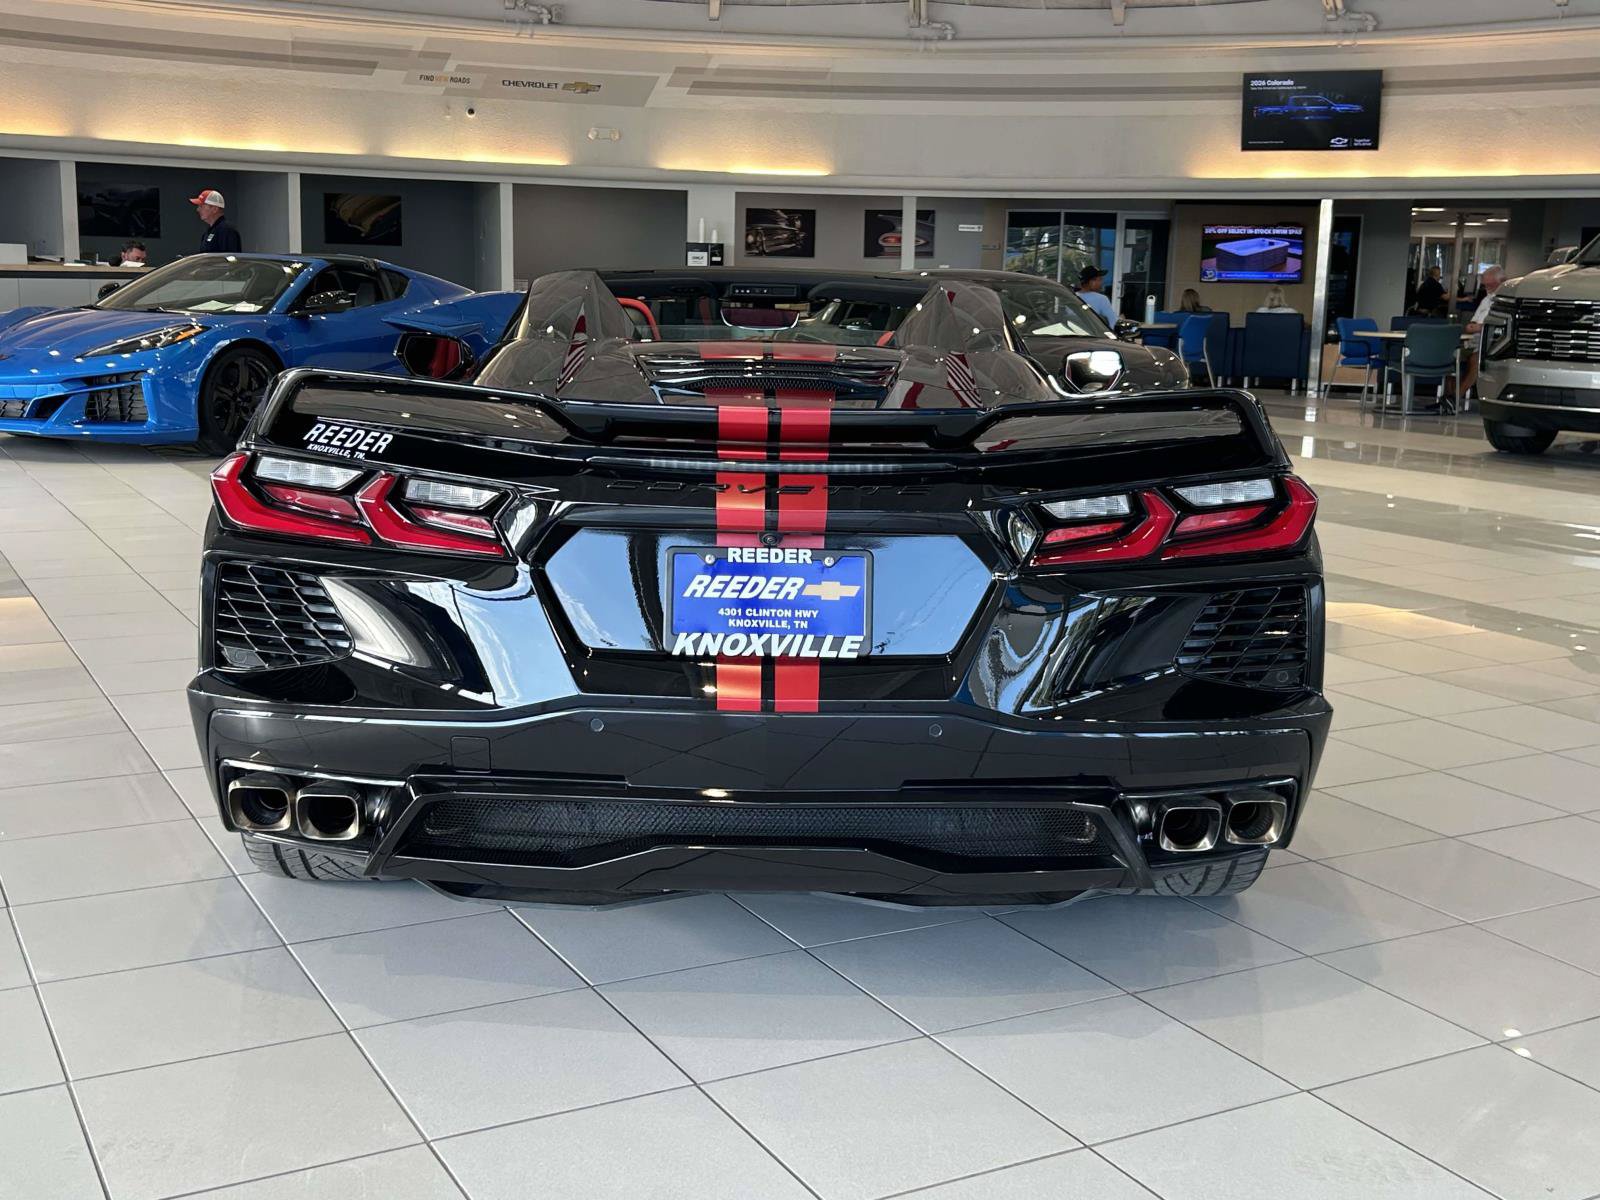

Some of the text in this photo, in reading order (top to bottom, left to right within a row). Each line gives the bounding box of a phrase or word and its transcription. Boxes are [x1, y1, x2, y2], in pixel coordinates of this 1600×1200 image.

[419, 74, 434, 82] FIND
[449, 76, 471, 84] ROADS
[502, 79, 559, 89] CHEVROLET
[1247, 228, 1272, 236] IN-STOCK
[1288, 228, 1302, 236] SPAS
[302, 423, 394, 454] REEDER
[307, 443, 351, 459] KNOXVILLE,
[606, 480, 933, 495] CORVETTE
[727, 547, 813, 564] REEDER
[682, 574, 805, 600] REEDER
[718, 608, 820, 619] 4301 CLINTON HWY
[728, 618, 808, 630] KNOXVILLE, TN
[671, 632, 865, 659] KNOXVILLE
